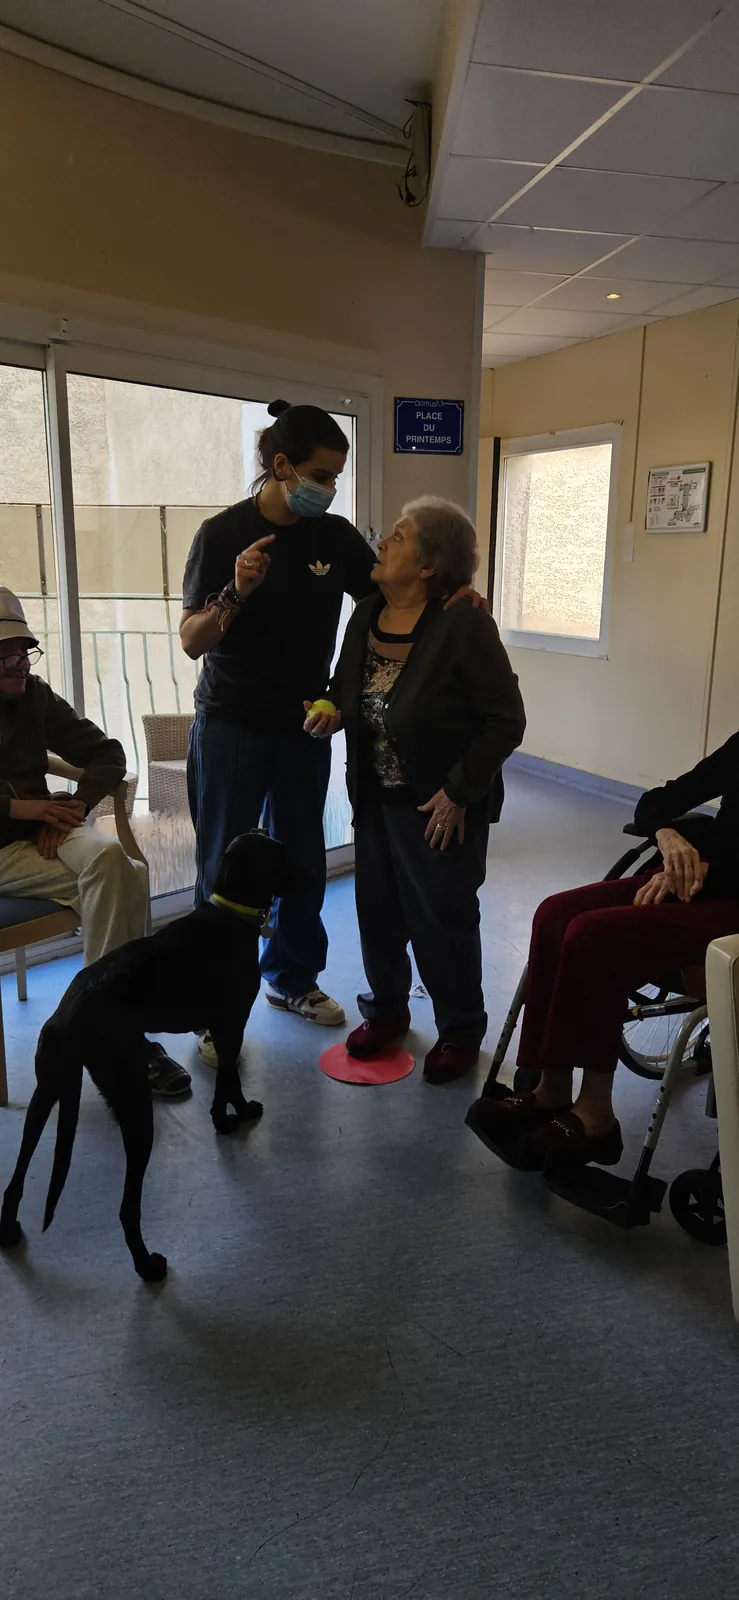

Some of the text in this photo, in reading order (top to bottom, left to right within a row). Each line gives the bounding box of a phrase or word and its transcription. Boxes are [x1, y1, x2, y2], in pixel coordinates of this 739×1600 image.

[416, 412, 443, 420] PLACE
[423, 424, 435, 432] DU
[406, 435, 452, 444] PRINTEMPS
